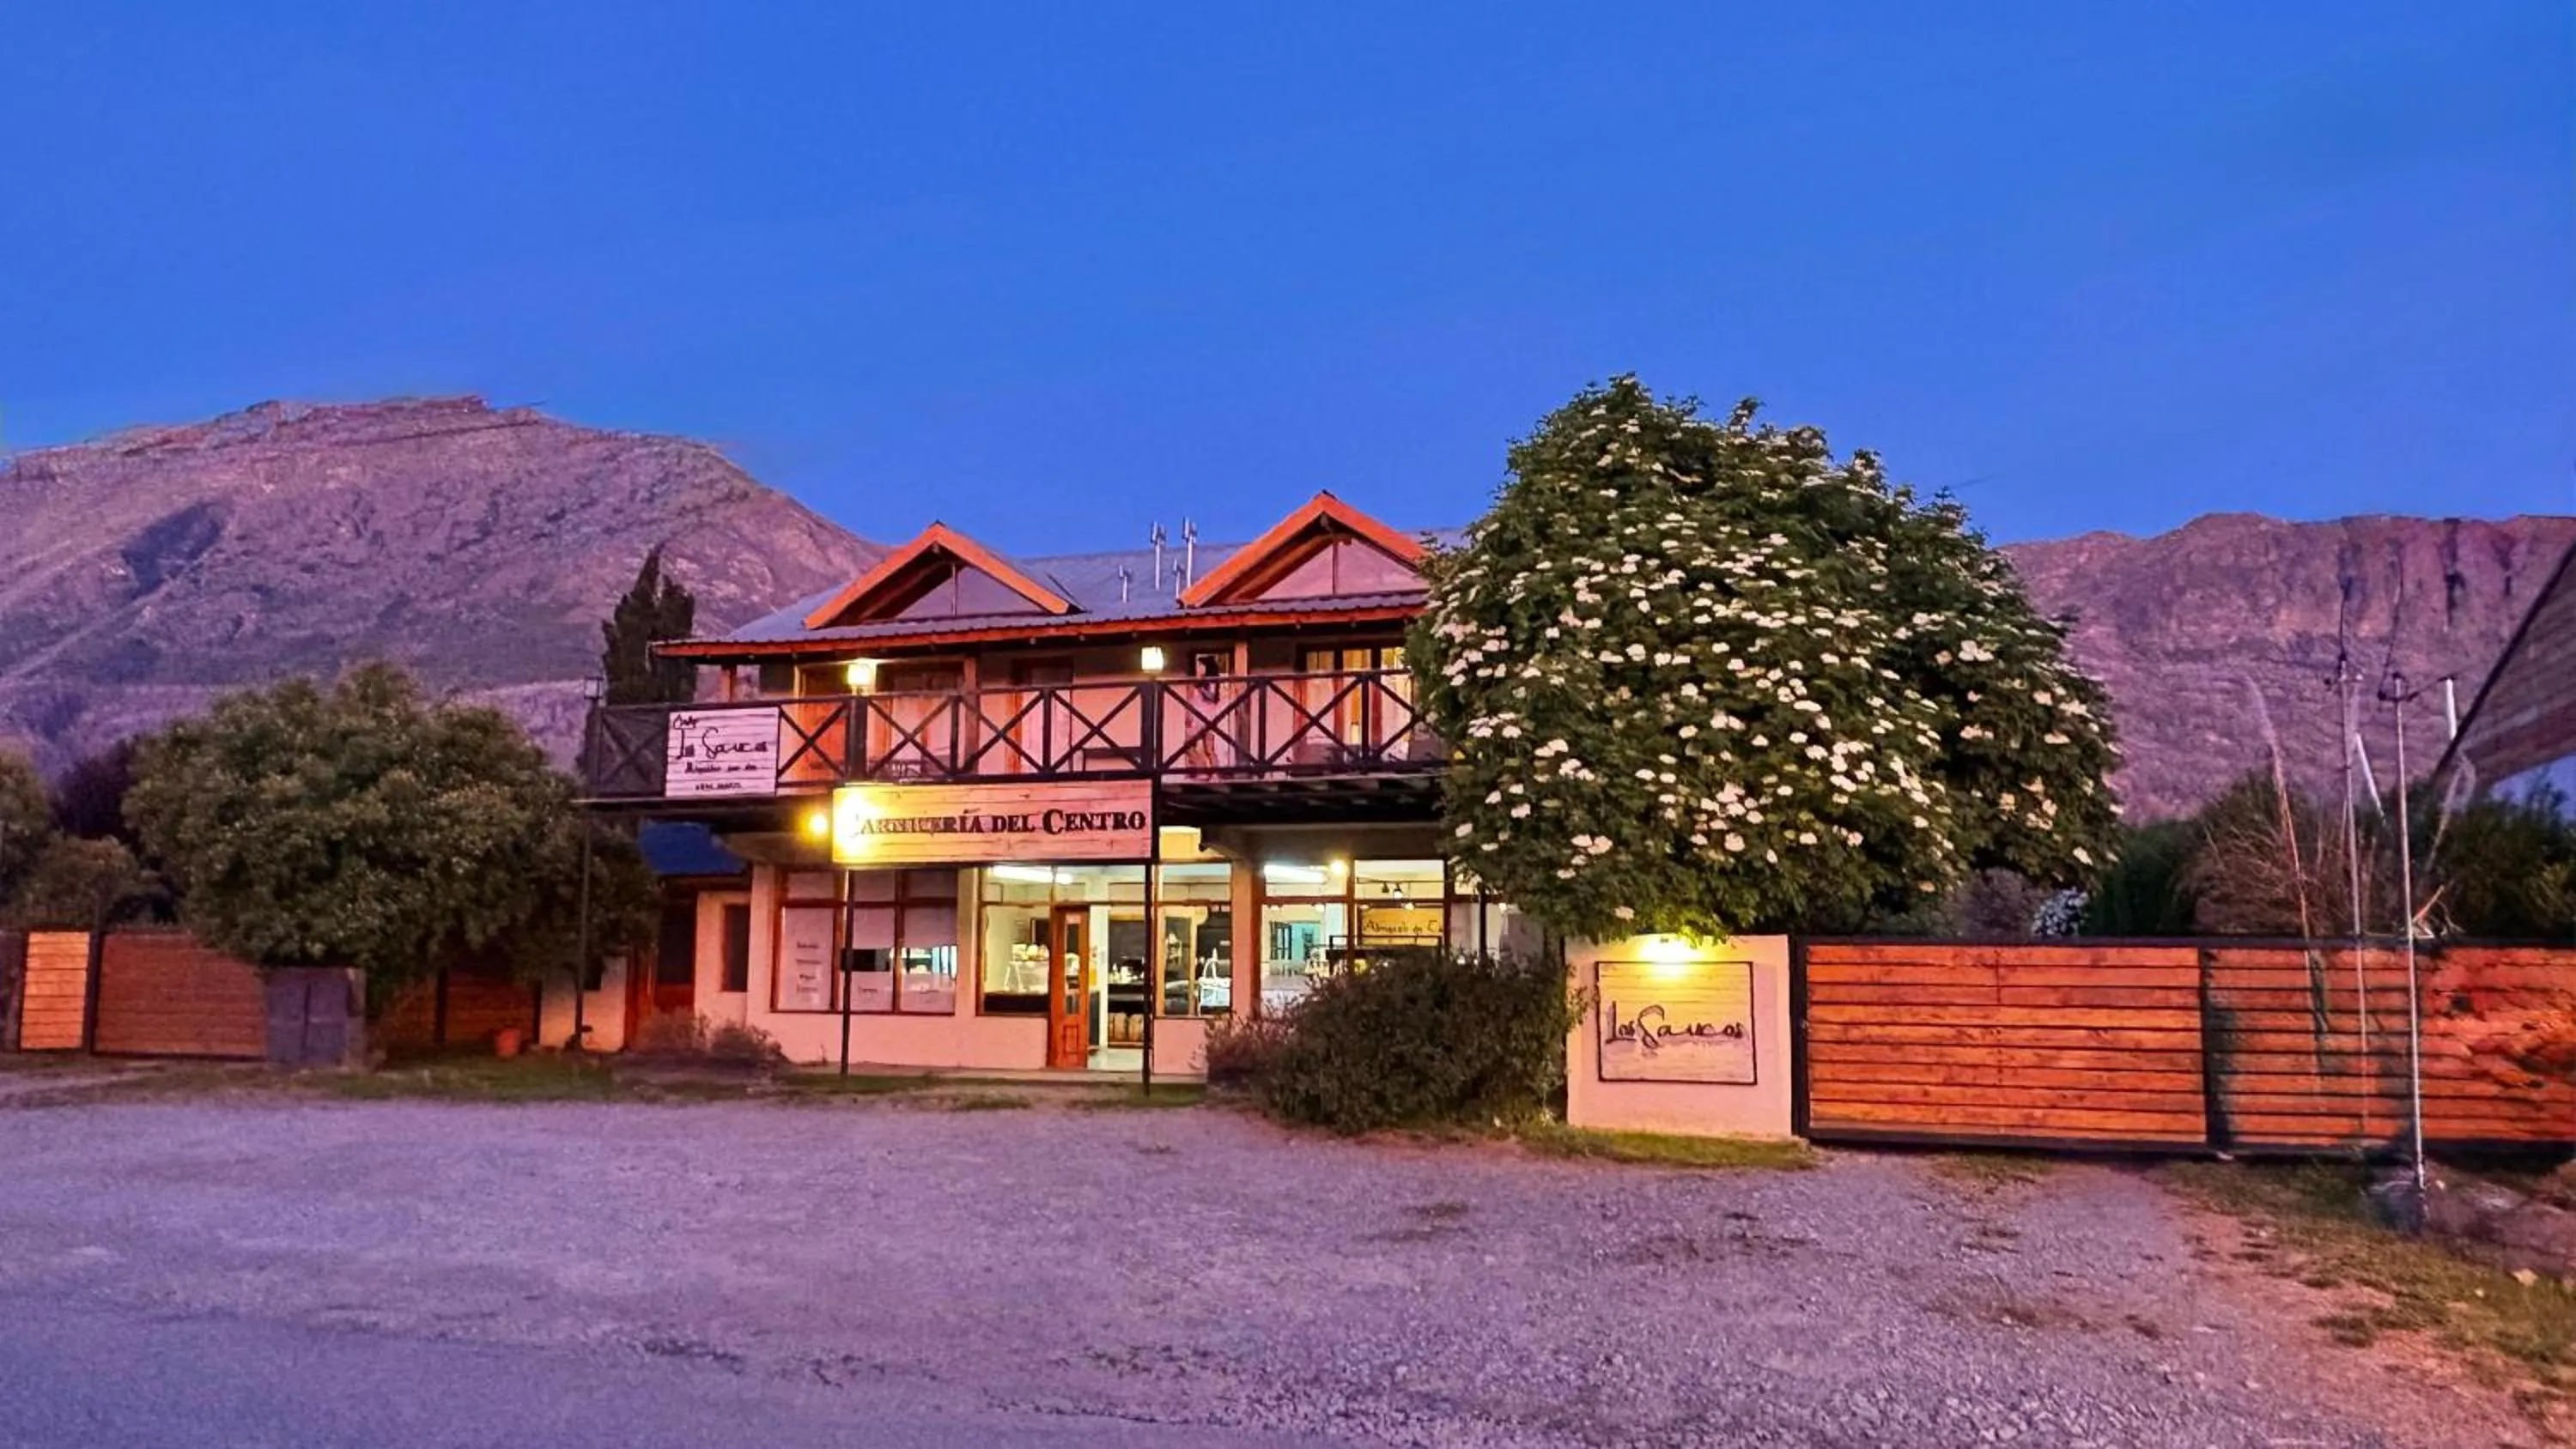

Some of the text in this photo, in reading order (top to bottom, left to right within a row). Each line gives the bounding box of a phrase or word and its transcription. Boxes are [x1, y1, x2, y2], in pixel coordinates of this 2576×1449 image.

[991, 814, 1036, 833] DEL
[1042, 809, 1147, 834] CENTRO
[1605, 1001, 1637, 1045] Los
